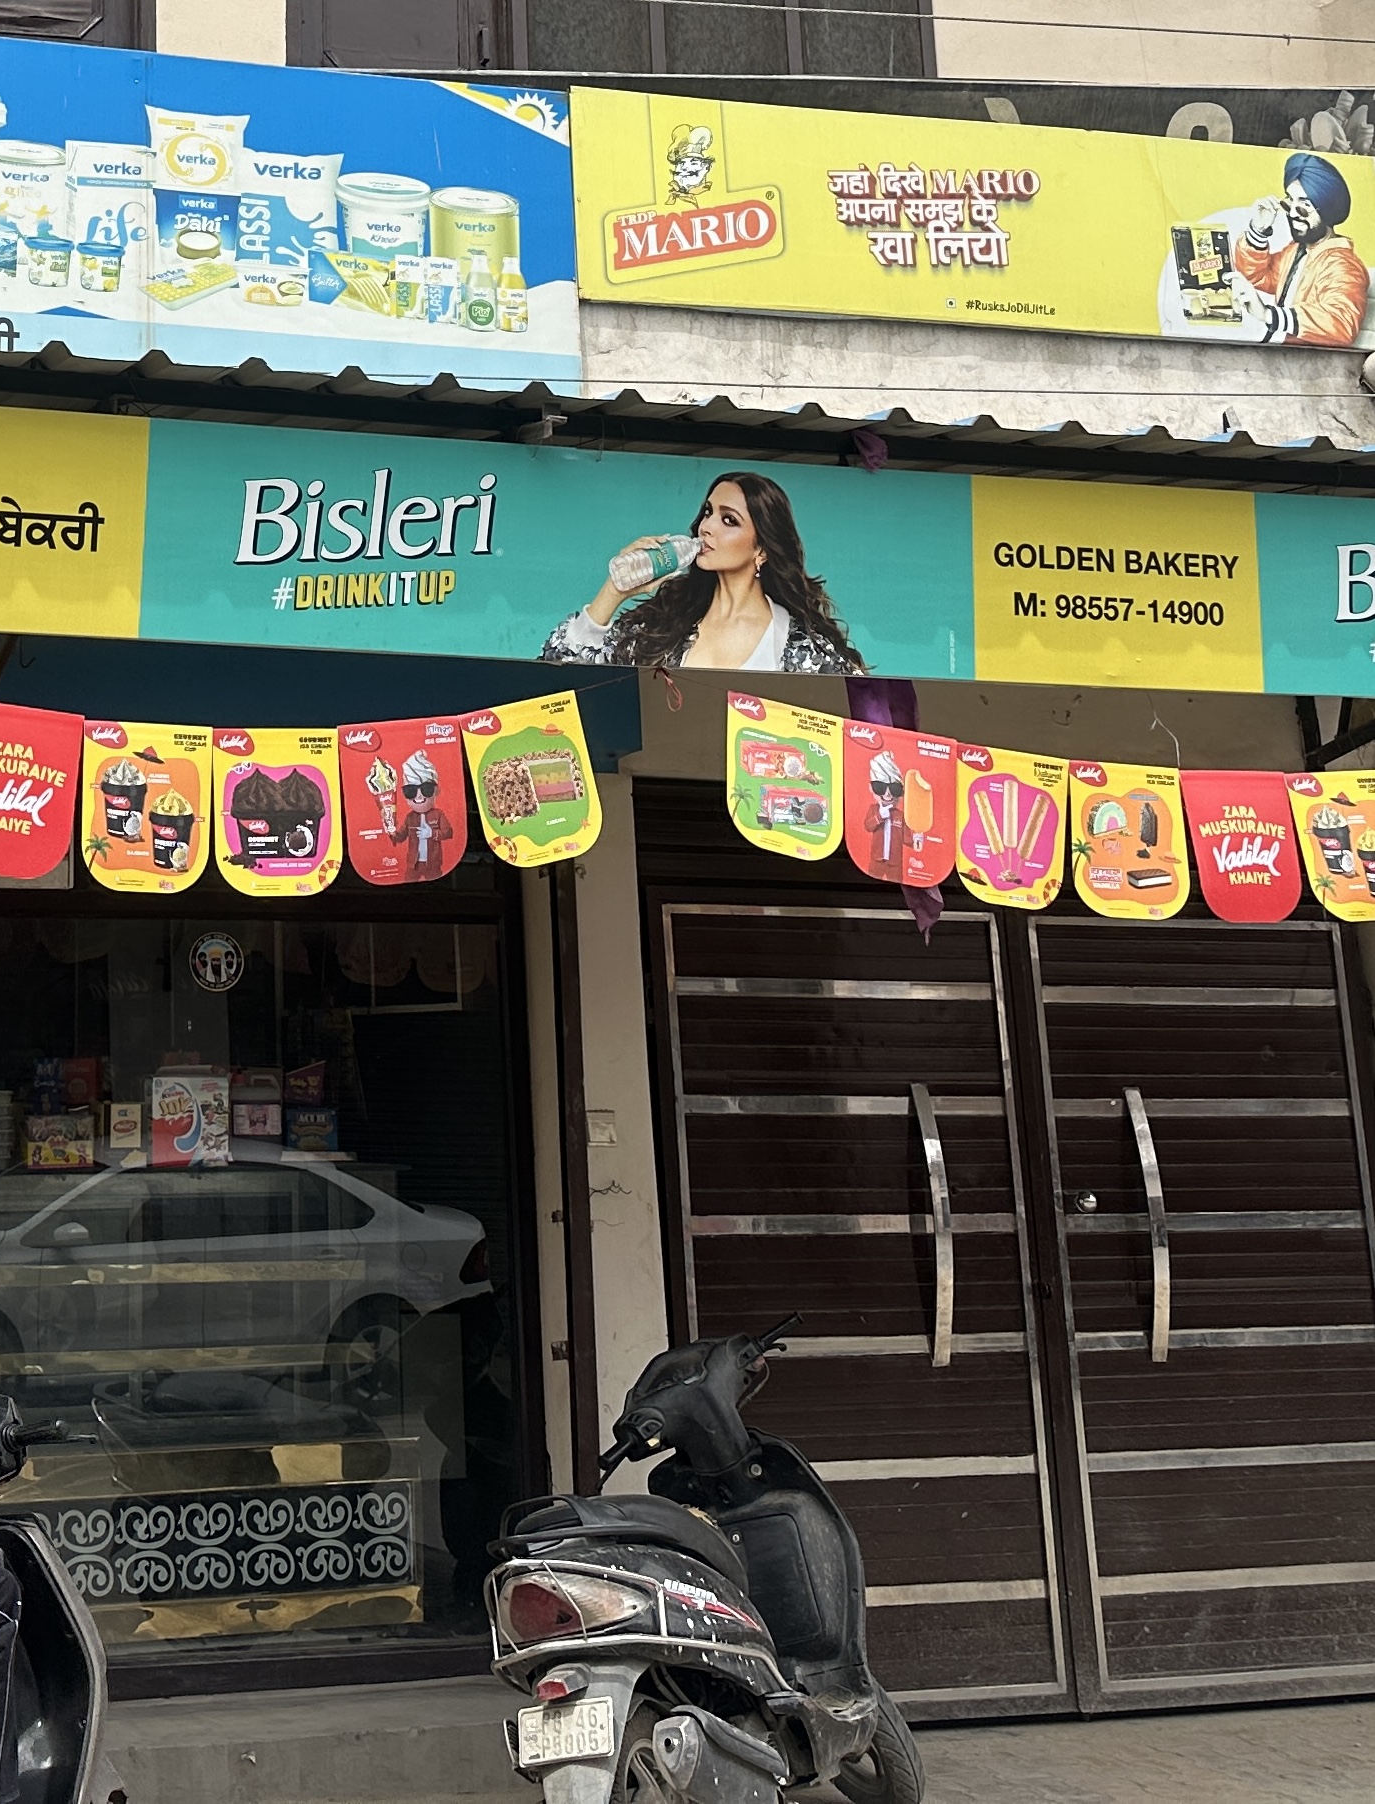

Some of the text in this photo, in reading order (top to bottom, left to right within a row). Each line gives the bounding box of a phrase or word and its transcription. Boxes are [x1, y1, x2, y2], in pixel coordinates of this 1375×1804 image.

[177, 153, 216, 166] verka
[1, 171, 50, 182] verka
[93, 162, 142, 176] verka
[253, 162, 322, 180] verka
[876, 161, 926, 197] दिखे
[929, 168, 1041, 198] MARIO
[182, 198, 216, 209] verka
[970, 191, 998, 228] के
[86, 201, 150, 247] Life
[174, 213, 221, 233] Dahi
[238, 197, 271, 265] LASSI
[366, 222, 401, 233] verka
[454, 221, 496, 232] verka
[621, 205, 770, 262] MARIO
[335, 258, 368, 271] verka
[244, 273, 276, 284] verka
[233, 467, 498, 567] Bisleri
[993, 541, 1239, 580] GOLDEN BAKERY
[271, 569, 456, 612] #DRINKITUP
[1013, 591, 1224, 627] M: 98557-14900
[734, 697, 761, 717] Vadilal
[467, 715, 494, 732] Vadilal
[91, 726, 122, 744] Vadilal
[219, 734, 248, 751] Vadilal
[345, 730, 374, 746] Vadilal
[850, 726, 877, 744] Vadilal
[961, 749, 988, 767] Vadilal
[1222, 805, 1257, 819] ZARA
[1198, 819, 1287, 840] MUSKURAIYE
[1212, 835, 1281, 877] Vadilal
[1228, 871, 1272, 886] KHAIYE
[576, 1706, 598, 1730] 46
